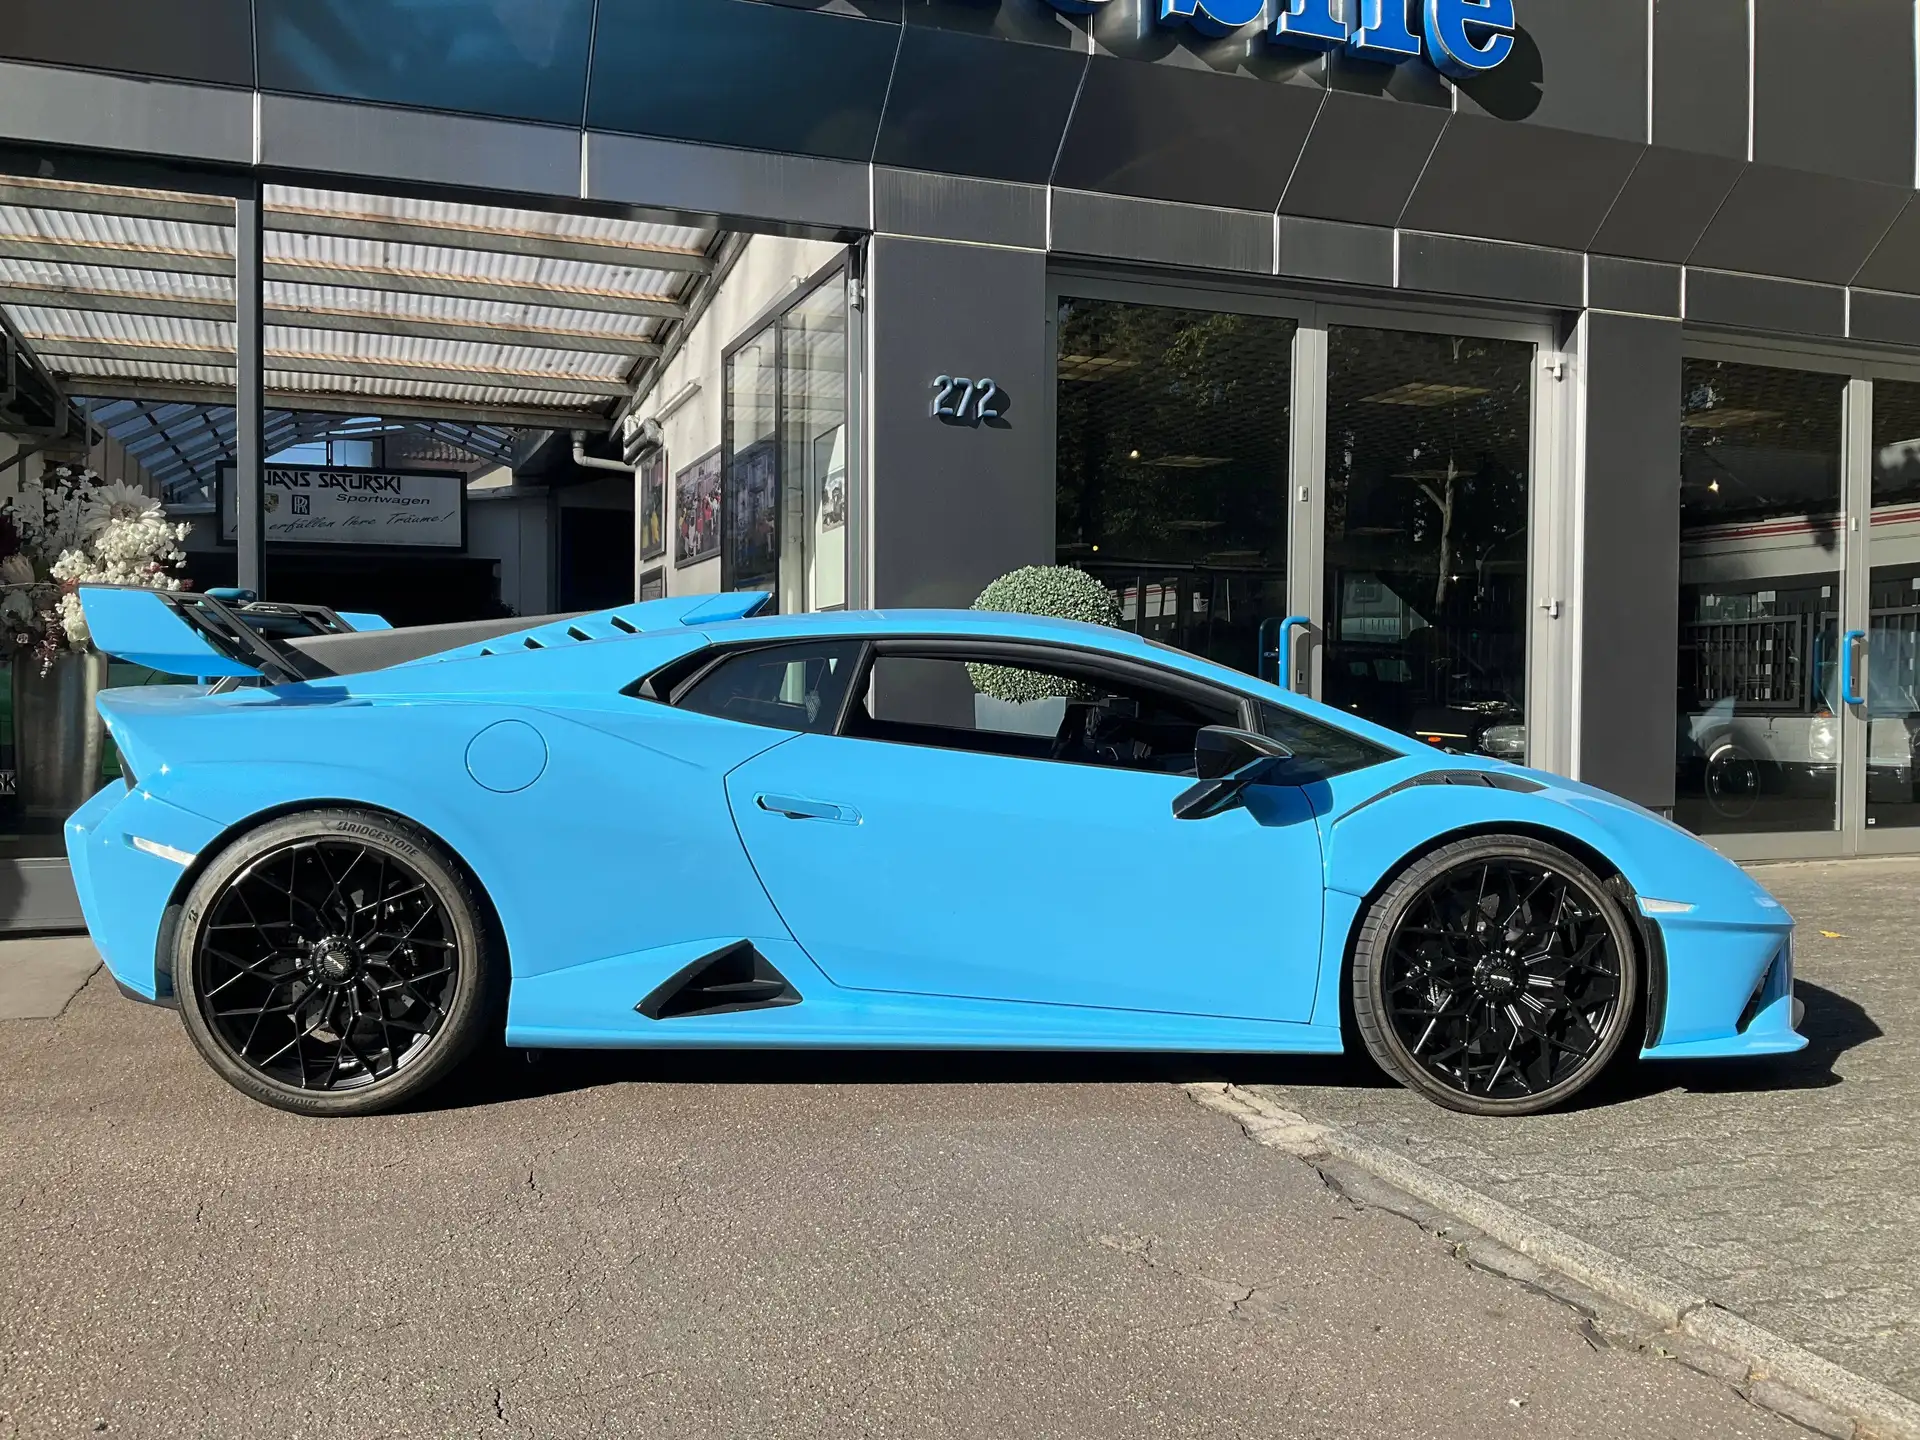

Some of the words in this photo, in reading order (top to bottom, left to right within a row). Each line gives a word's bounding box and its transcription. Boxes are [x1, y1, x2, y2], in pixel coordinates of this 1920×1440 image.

[933, 375, 997, 417] 272
[318, 472, 401, 494] SATURSKI
[336, 493, 430, 506] Sportwagen
[386, 511, 455, 525] Träume!
[336, 821, 420, 857] BRIDGESTONE
